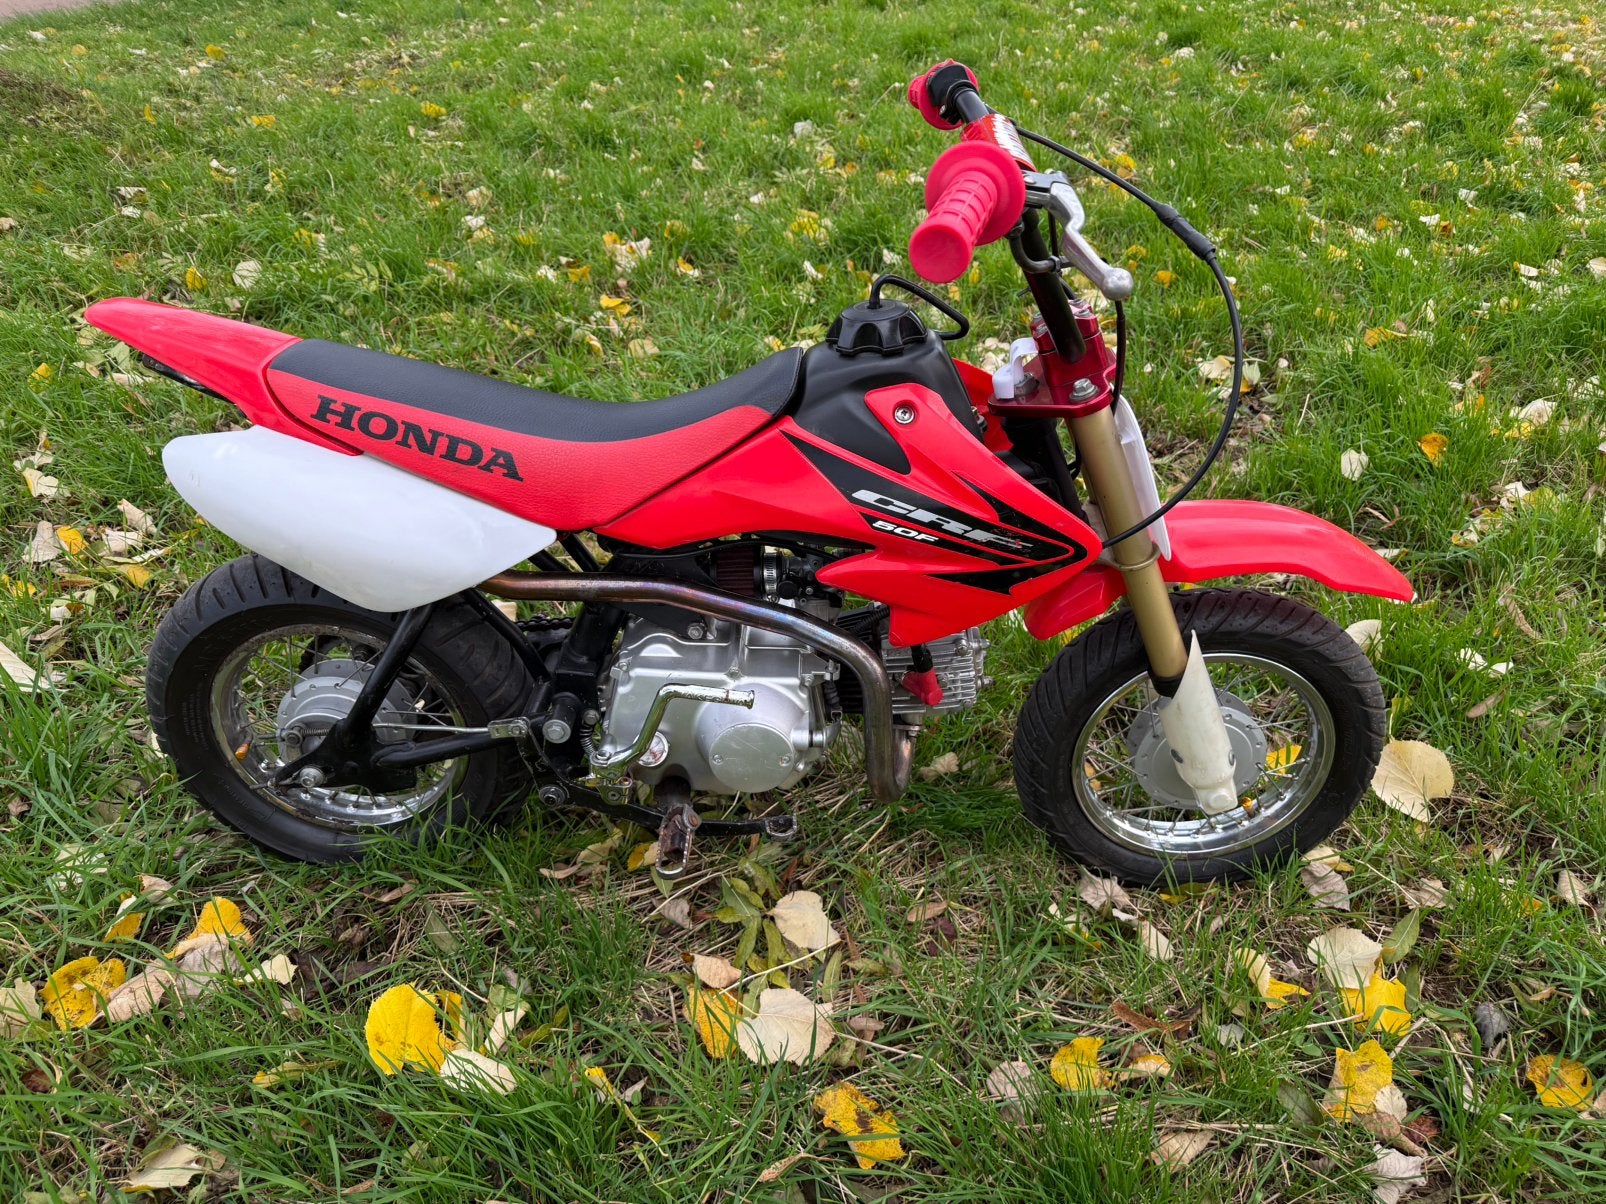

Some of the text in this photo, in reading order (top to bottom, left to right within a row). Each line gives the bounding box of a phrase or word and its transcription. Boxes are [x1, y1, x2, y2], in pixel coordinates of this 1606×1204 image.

[311, 395, 523, 481] HONDA
[852, 490, 1033, 548] CRF
[872, 520, 939, 542] 50F
